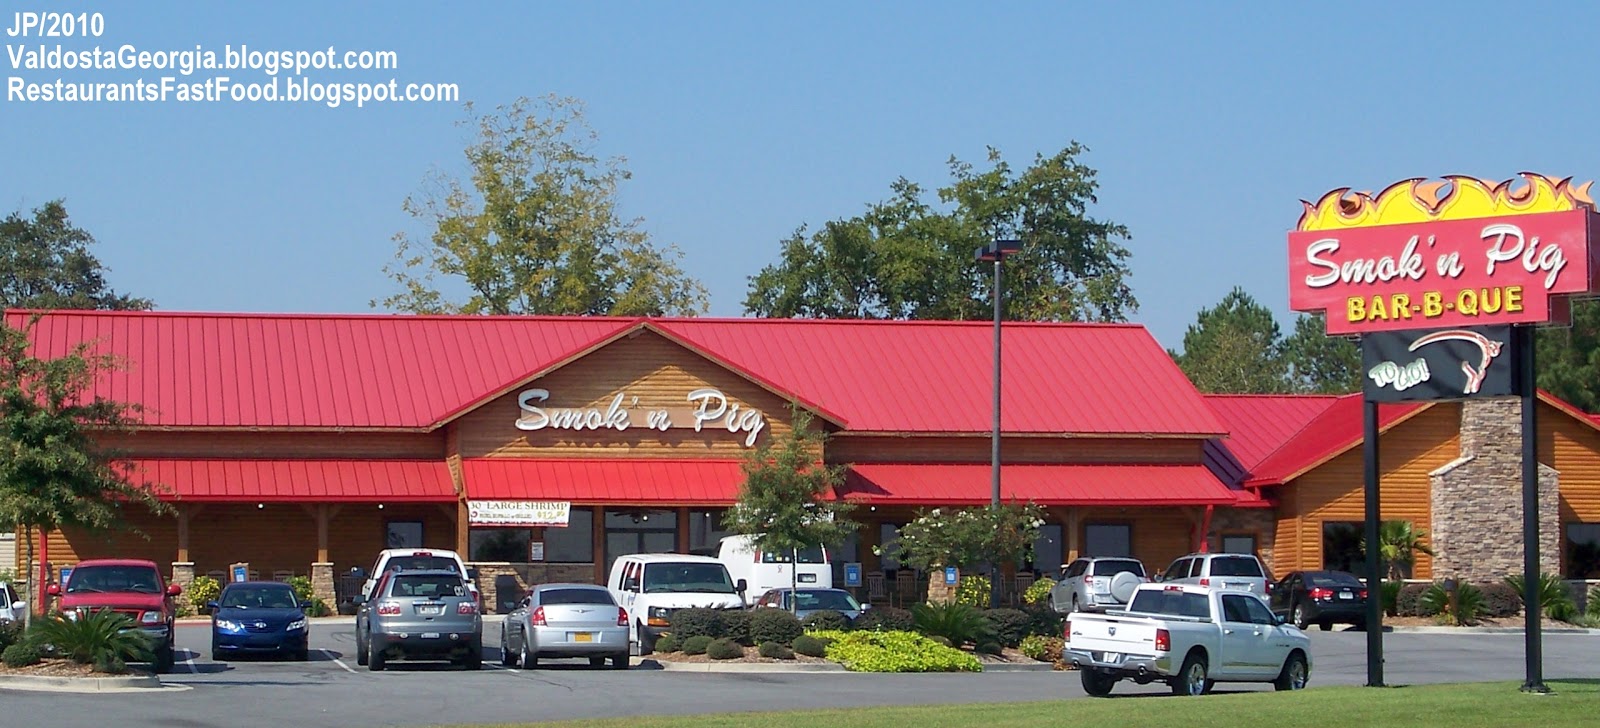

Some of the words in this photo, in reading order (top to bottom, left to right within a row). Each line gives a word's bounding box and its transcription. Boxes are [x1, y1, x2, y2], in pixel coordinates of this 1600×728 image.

[1305, 234, 1464, 288] Smok'n
[1480, 223, 1568, 289] Pig
[1347, 286, 1524, 322] BAR-B-QUE
[687, 388, 765, 447] Pig
[471, 502, 481, 510] 30
[487, 502, 523, 510] LARGE
[525, 502, 567, 510] SHRIMP
